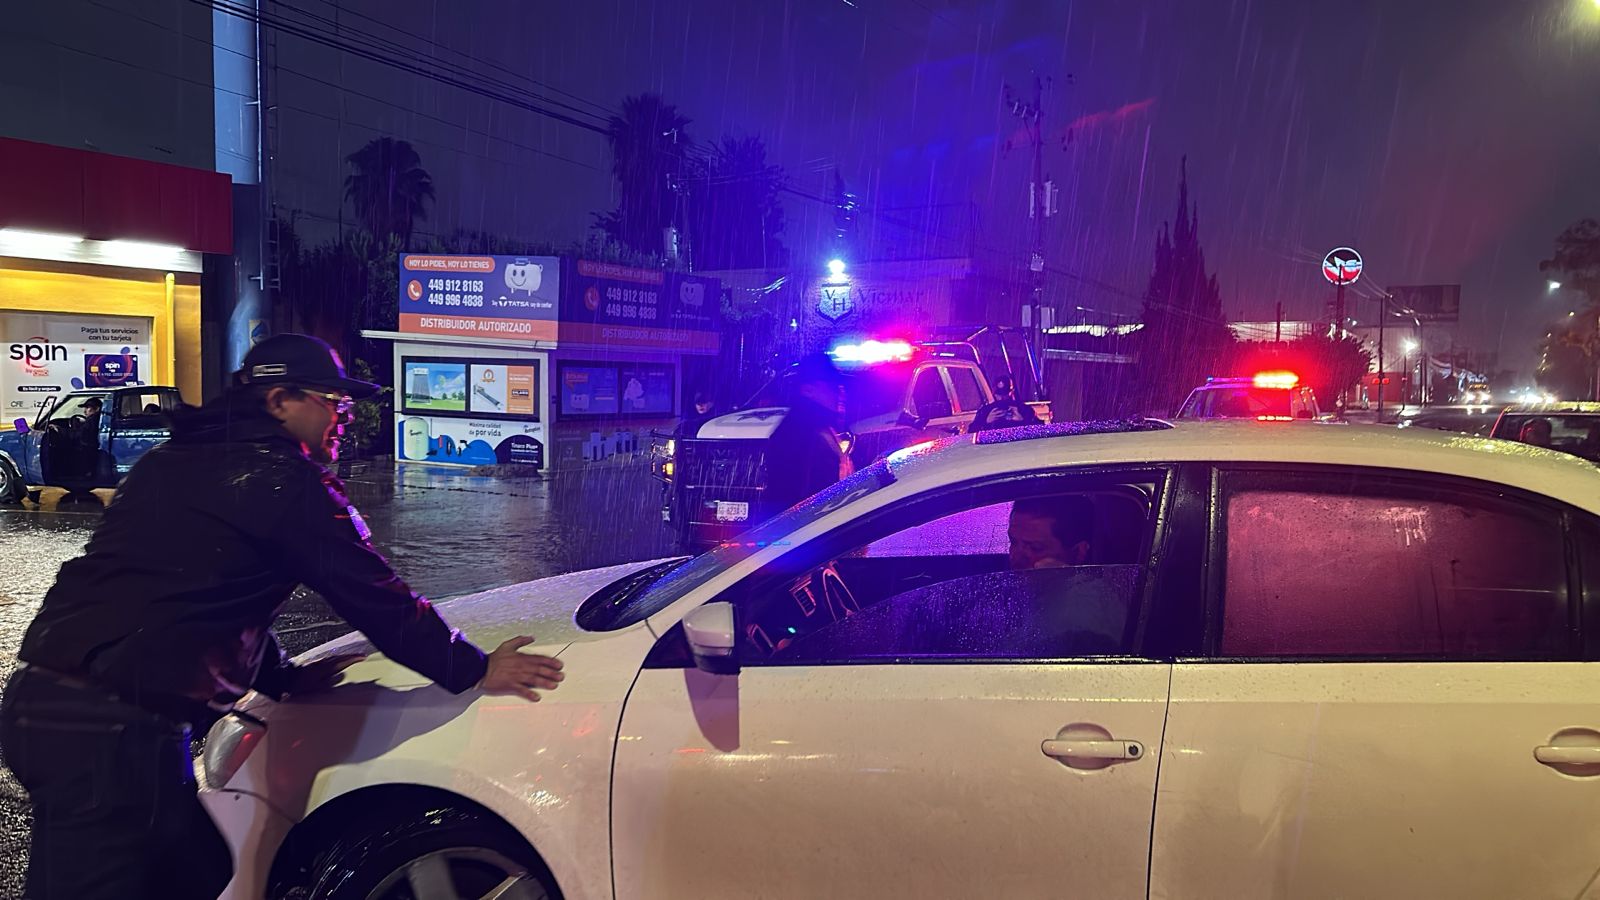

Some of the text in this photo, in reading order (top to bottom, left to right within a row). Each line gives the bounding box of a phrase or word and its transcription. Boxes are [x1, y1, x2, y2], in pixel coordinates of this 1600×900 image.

[409, 259, 420, 267] HOY
[421, 259, 428, 267] LO
[448, 260, 459, 268] HOY
[469, 261, 489, 269] TIENES
[428, 279, 483, 293] 449 912 8163
[428, 293, 483, 307] 449 996 4838
[606, 287, 621, 300] 449
[622, 289, 637, 302] 912
[605, 303, 621, 317] 449
[81, 326, 98, 334] Paga
[420, 317, 532, 333] DISTRIBUIDOR AUTORIZADO
[10, 343, 67, 366] spin
[105, 361, 120, 370] spin
[487, 429, 502, 437] vida
